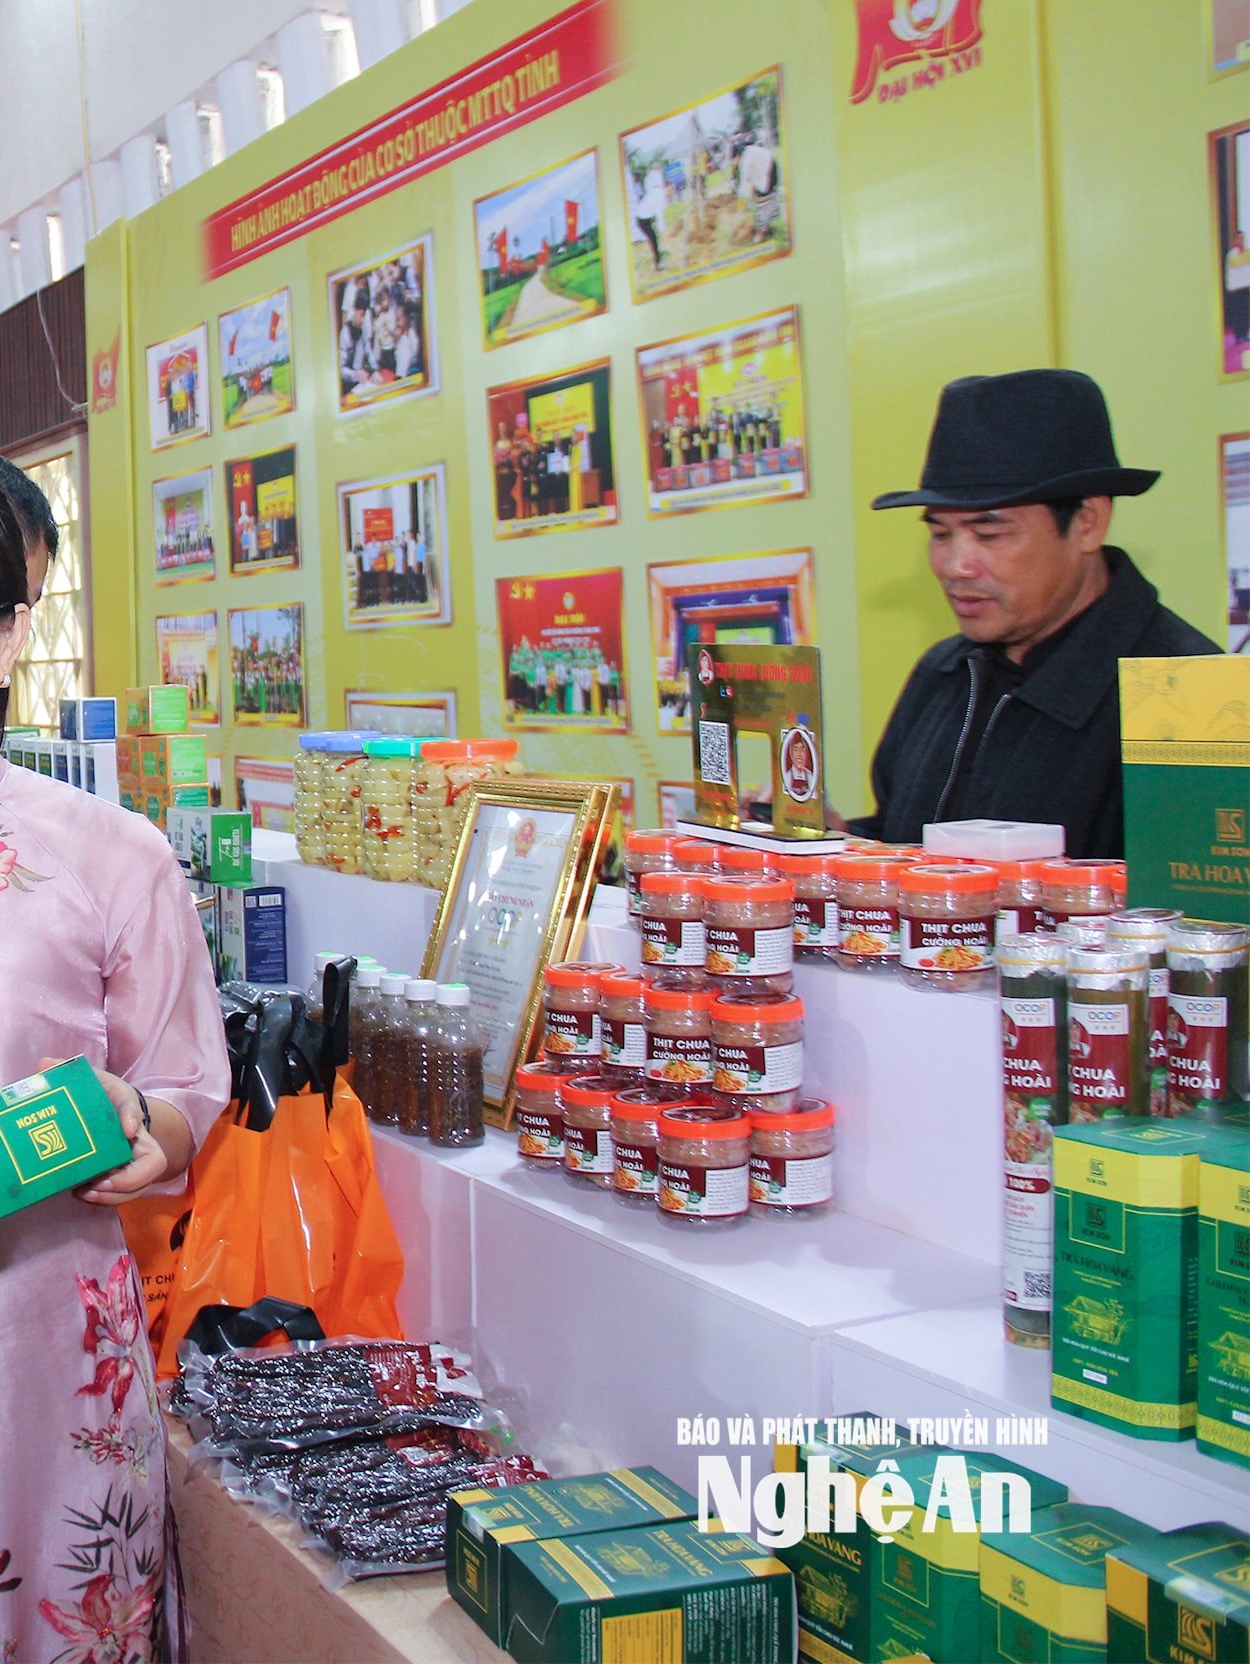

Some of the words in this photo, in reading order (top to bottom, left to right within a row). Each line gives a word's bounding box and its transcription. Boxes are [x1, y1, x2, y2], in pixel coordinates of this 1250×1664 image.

[950, 47, 982, 76] XVI
[231, 214, 256, 252] HÌNH
[256, 201, 281, 241] ẢNH
[281, 183, 312, 225] HOẠT
[312, 168, 348, 209] ĐỘNG
[349, 148, 376, 190] CỦA
[376, 144, 396, 181] CƠ
[396, 121, 416, 171] SỞ
[415, 100, 468, 147] THUỘC
[468, 79, 514, 127] MTTQ
[514, 51, 561, 104] TỈNH
[1205, 864, 1244, 885] HOA
[855, 909, 892, 921] CHUA
[643, 920, 667, 932] CHUA
[921, 922, 950, 936] THỊT
[951, 921, 988, 934] CHUA
[710, 930, 739, 942] CHUA
[921, 933, 962, 947] CƯỜNG
[716, 942, 740, 953] HOÀI
[1186, 1001, 1220, 1012] OCOP
[551, 1012, 578, 1024] CHUA
[558, 1024, 579, 1035] HOÀI
[653, 1037, 674, 1050] THỊT
[676, 1039, 710, 1049] CHUA
[652, 1050, 685, 1061] CƯỜNG
[718, 1047, 748, 1059] CHUA
[726, 1060, 750, 1072] HOÀI
[1170, 1056, 1211, 1073] CHUA
[1072, 1066, 1116, 1081] CHUA
[1011, 1072, 1052, 1089] HOÀI
[1178, 1073, 1221, 1090] HOÀI
[1082, 1081, 1126, 1098] HOÀI
[37, 1105, 57, 1120] KIM
[15, 1113, 38, 1129] SON
[523, 1114, 550, 1127] CHUA
[530, 1126, 550, 1138] HOÀI
[616, 1145, 643, 1160] CHUA
[622, 1160, 644, 1171] HOÀI
[750, 1158, 771, 1171] HUA
[662, 1165, 690, 1180] CHUA
[668, 1180, 691, 1192] HOÀI
